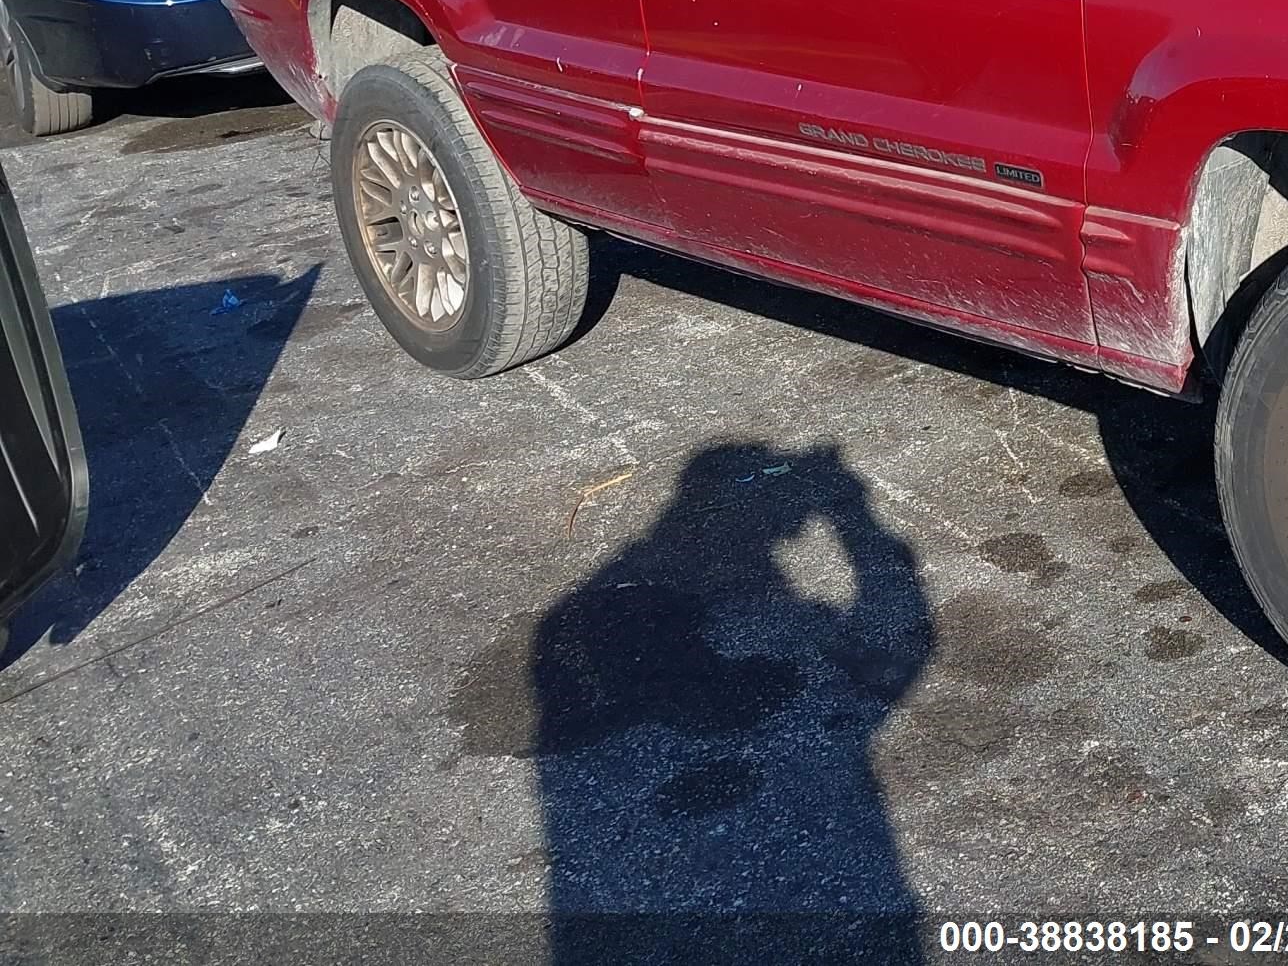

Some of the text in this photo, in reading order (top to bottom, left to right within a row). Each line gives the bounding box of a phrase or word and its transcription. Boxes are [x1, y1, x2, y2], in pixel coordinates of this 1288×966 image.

[798, 121, 986, 173] GRAND CHEROKEE
[995, 164, 1041, 183] LIMITED
